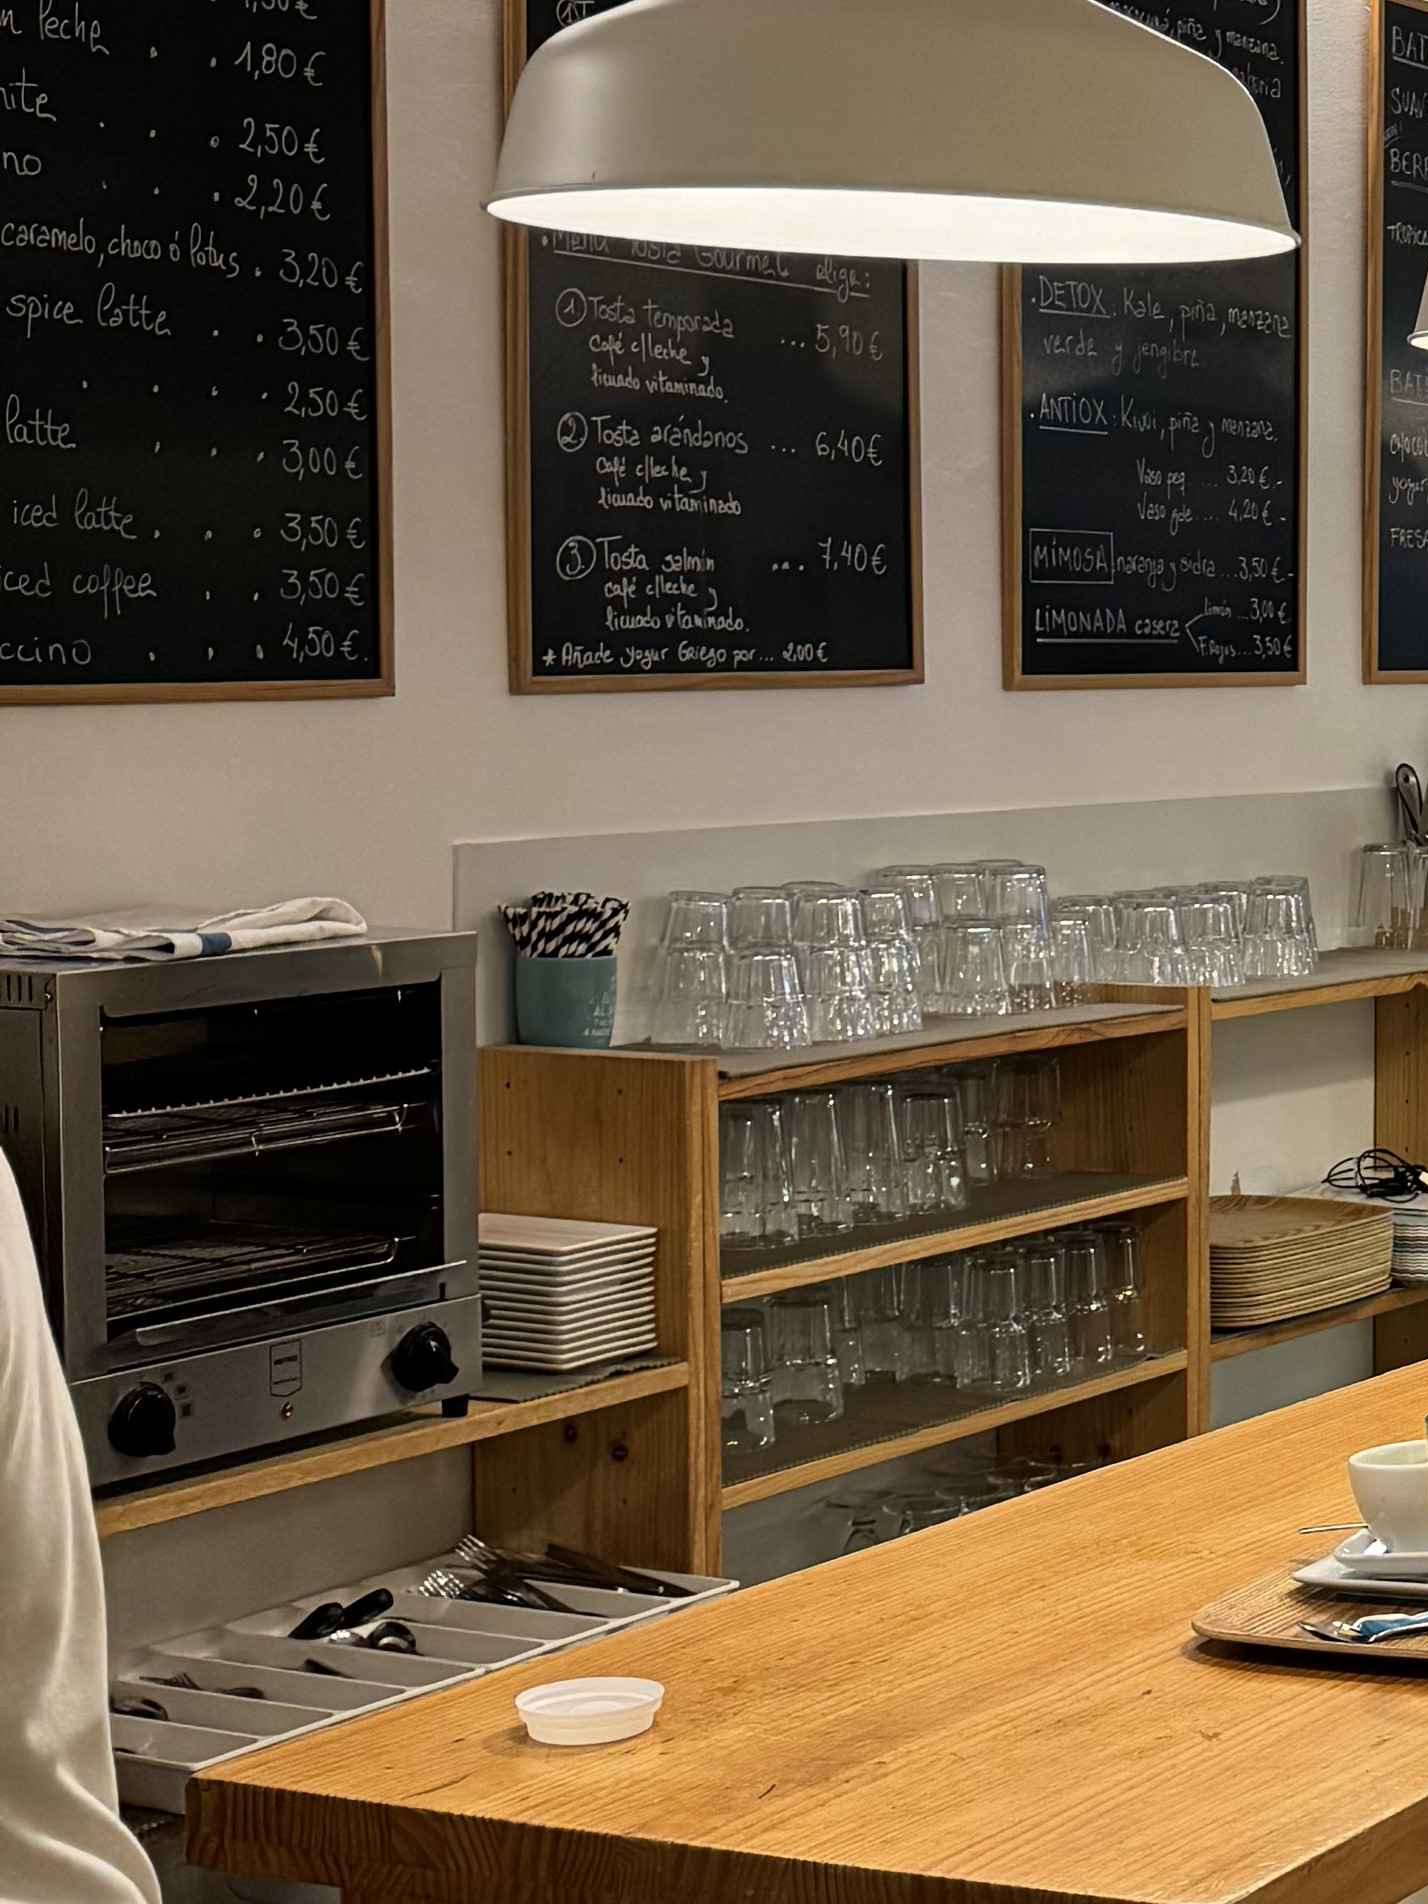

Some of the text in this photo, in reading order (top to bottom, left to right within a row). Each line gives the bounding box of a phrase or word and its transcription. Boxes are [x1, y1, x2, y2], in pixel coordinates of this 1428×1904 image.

[6, 294, 83, 339] spice
[97, 282, 171, 336] latte
[588, 296, 636, 326] Tosta
[643, 299, 735, 339] temporada
[589, 332, 625, 358] Café
[697, 354, 710, 377] y
[1042, 327, 1098, 357] verde
[5, 394, 76, 448] latte
[591, 415, 641, 448] Tosta
[650, 416, 749, 454] arándanos
[12, 494, 60, 527] iced
[74, 488, 137, 539] latte
[596, 535, 649, 571] Tosta
[73, 563, 157, 620] coffee
[561, 642, 615, 667] Añade
[620, 645, 668, 670] yogur
